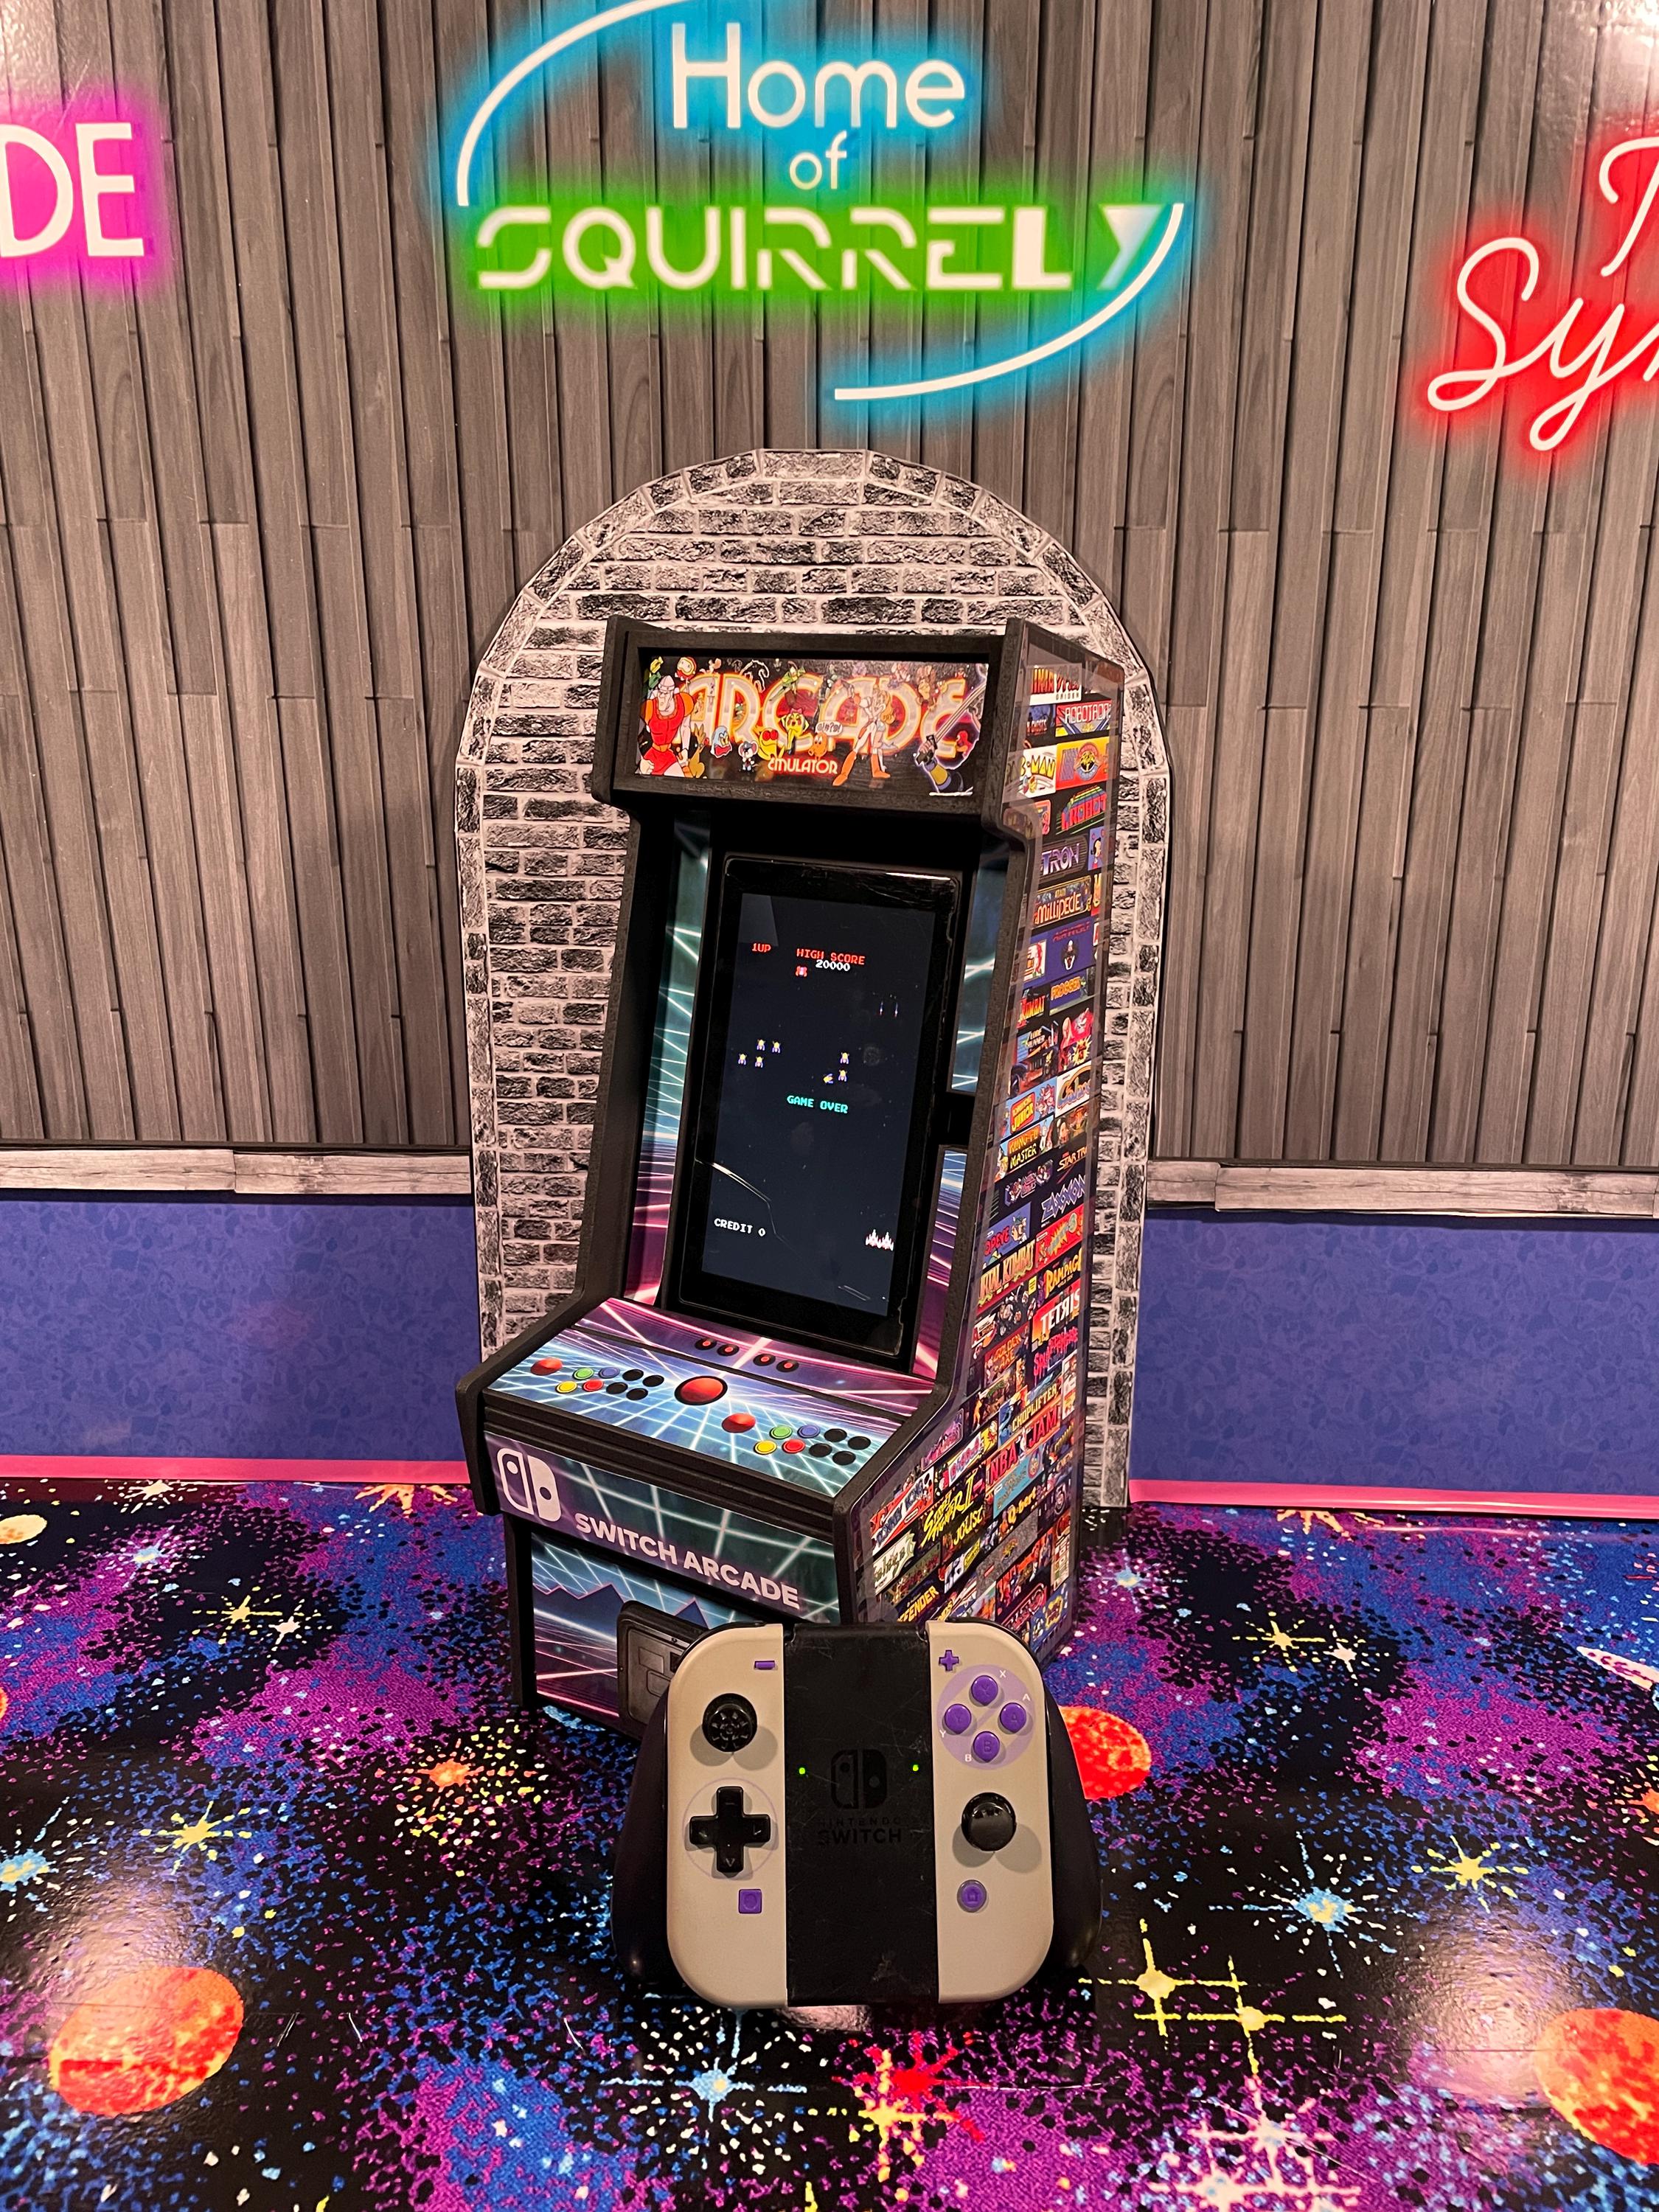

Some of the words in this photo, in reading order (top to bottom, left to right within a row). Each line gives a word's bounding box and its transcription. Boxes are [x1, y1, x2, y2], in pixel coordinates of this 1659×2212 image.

[672, 23, 965, 129] Home
[790, 131, 847, 190] of
[476, 206, 1163, 291] SQUIRRELY
[1427, 237, 1659, 451] Sy
[672, 671, 966, 759] ARCADE
[768, 757, 838, 775] EMULATOR
[1041, 844, 1080, 876] TRON
[751, 942, 771, 953] 1UP
[796, 948, 824, 960] HIGH
[830, 952, 866, 965] SCORE
[815, 959, 851, 972] 20000
[787, 1095, 814, 1107] GAME
[820, 1100, 849, 1114] OVER
[1009, 1143, 1037, 1169] MASTER
[714, 1218, 753, 1234] CREDIT
[989, 1441, 1019, 1485] NBA
[1028, 1406, 1059, 1448] JAM
[953, 1505, 984, 1545] JOUST
[574, 1512, 678, 1565] SWITCH
[684, 1551, 801, 1610] ARCADE
[999, 1670, 1006, 1678] X
[1022, 1693, 1031, 1702] A
[939, 1730, 946, 1738] Y
[964, 1754, 973, 1762] B
[818, 1828, 901, 1845] SWITCH
